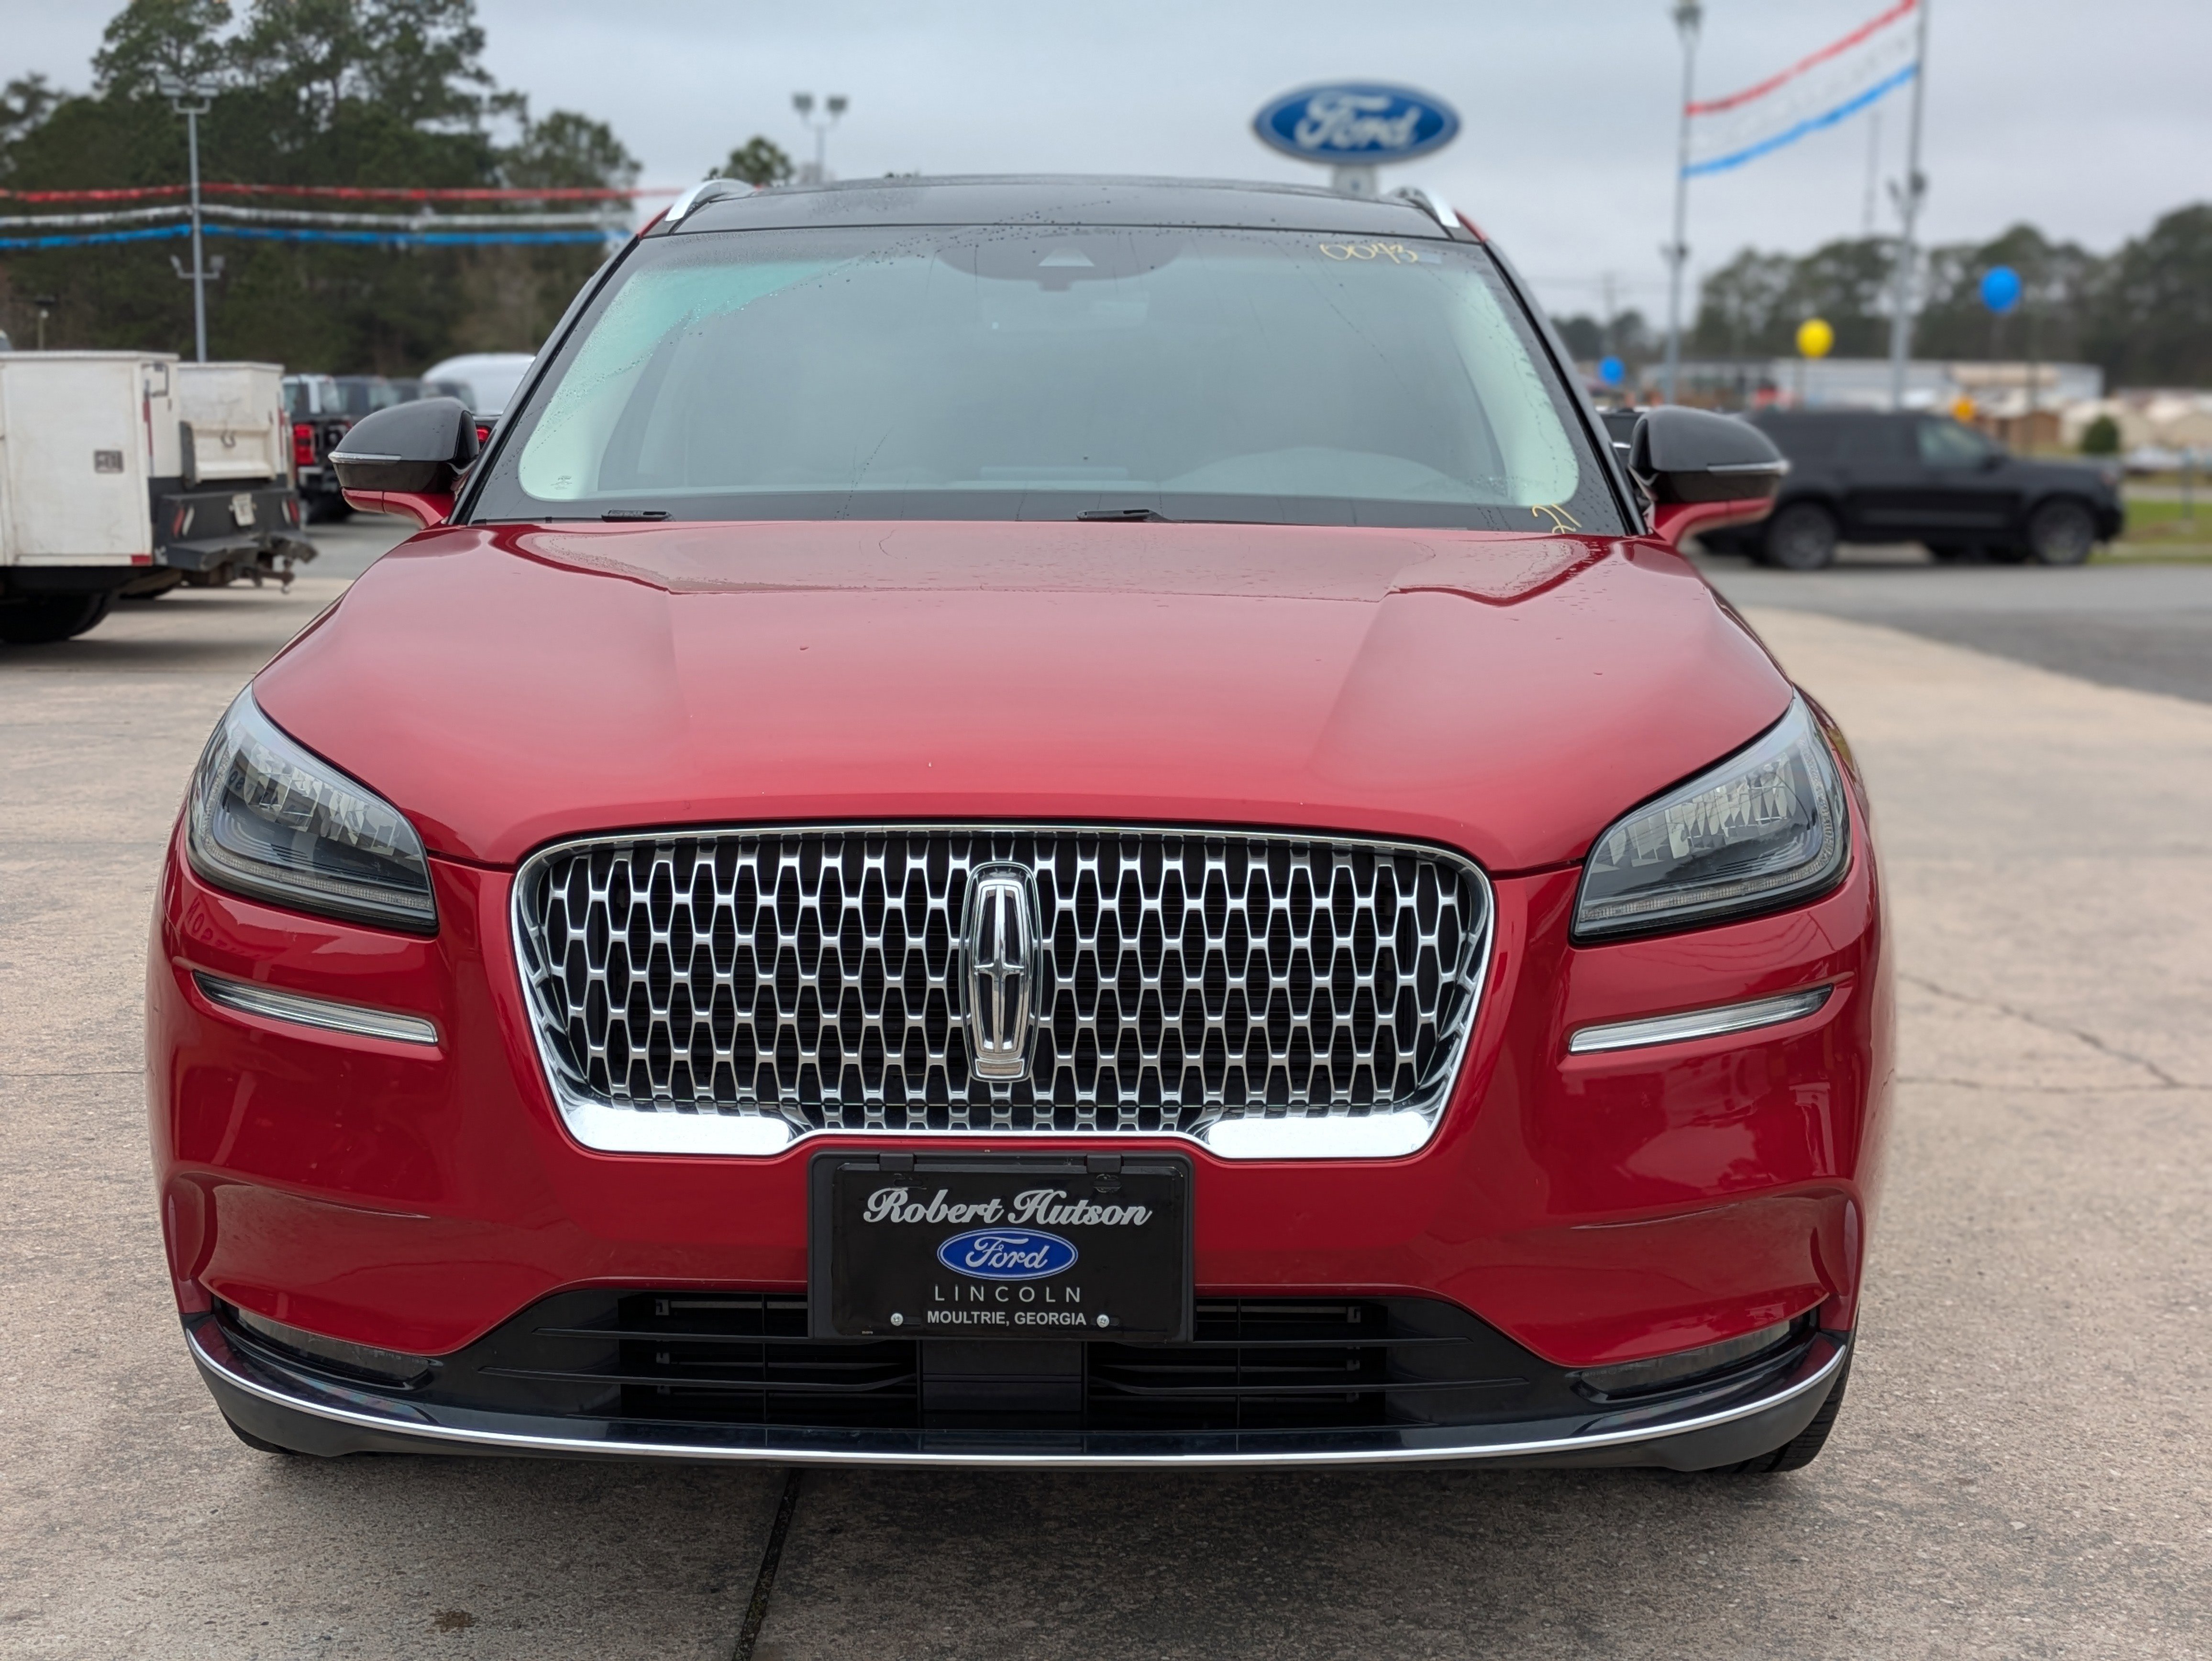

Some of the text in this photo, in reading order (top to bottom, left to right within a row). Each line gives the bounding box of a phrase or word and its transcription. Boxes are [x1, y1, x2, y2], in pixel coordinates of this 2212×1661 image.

[1294, 92, 1424, 148] Ford
[863, 1187, 1152, 1225] Robert Hutson
[965, 1237, 1051, 1268] Ford
[935, 1284, 1080, 1303] LINCOLN
[927, 1310, 1087, 1327] MOULTRIE, GEORGIA
